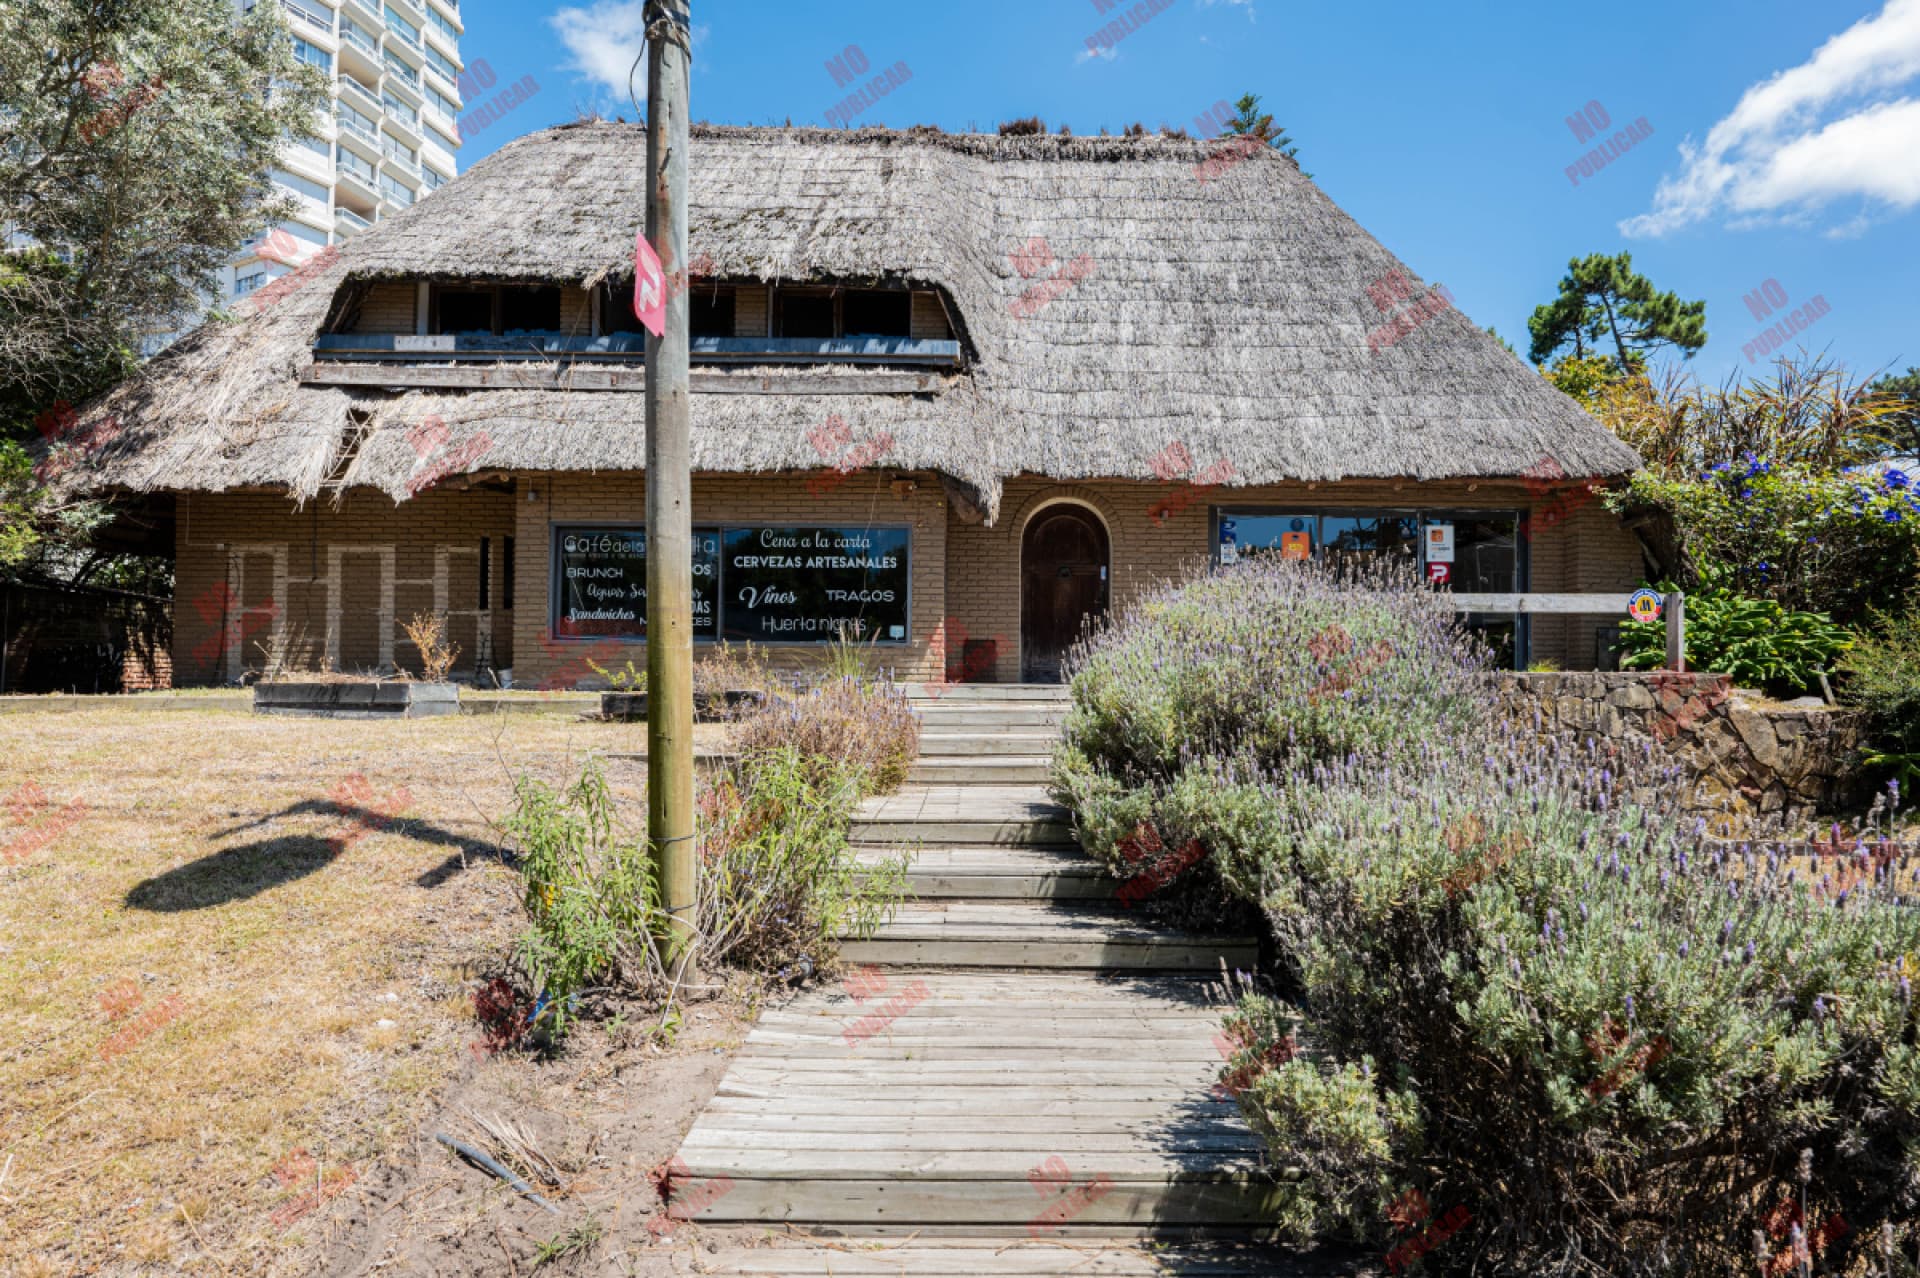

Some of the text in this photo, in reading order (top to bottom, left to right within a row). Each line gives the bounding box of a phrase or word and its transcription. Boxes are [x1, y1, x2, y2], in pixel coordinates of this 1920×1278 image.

[564, 534, 612, 553] Café
[760, 528, 871, 548] Cena a la carta
[733, 556, 897, 568] CERVEZAS ARTESANALES
[566, 567, 623, 578] BRUNCH
[587, 583, 625, 601] Aguas
[739, 585, 797, 608] Vinos
[826, 589, 895, 602] TRAGOS
[564, 607, 635, 623] Sandwiches
[762, 616, 817, 633] Huerta
